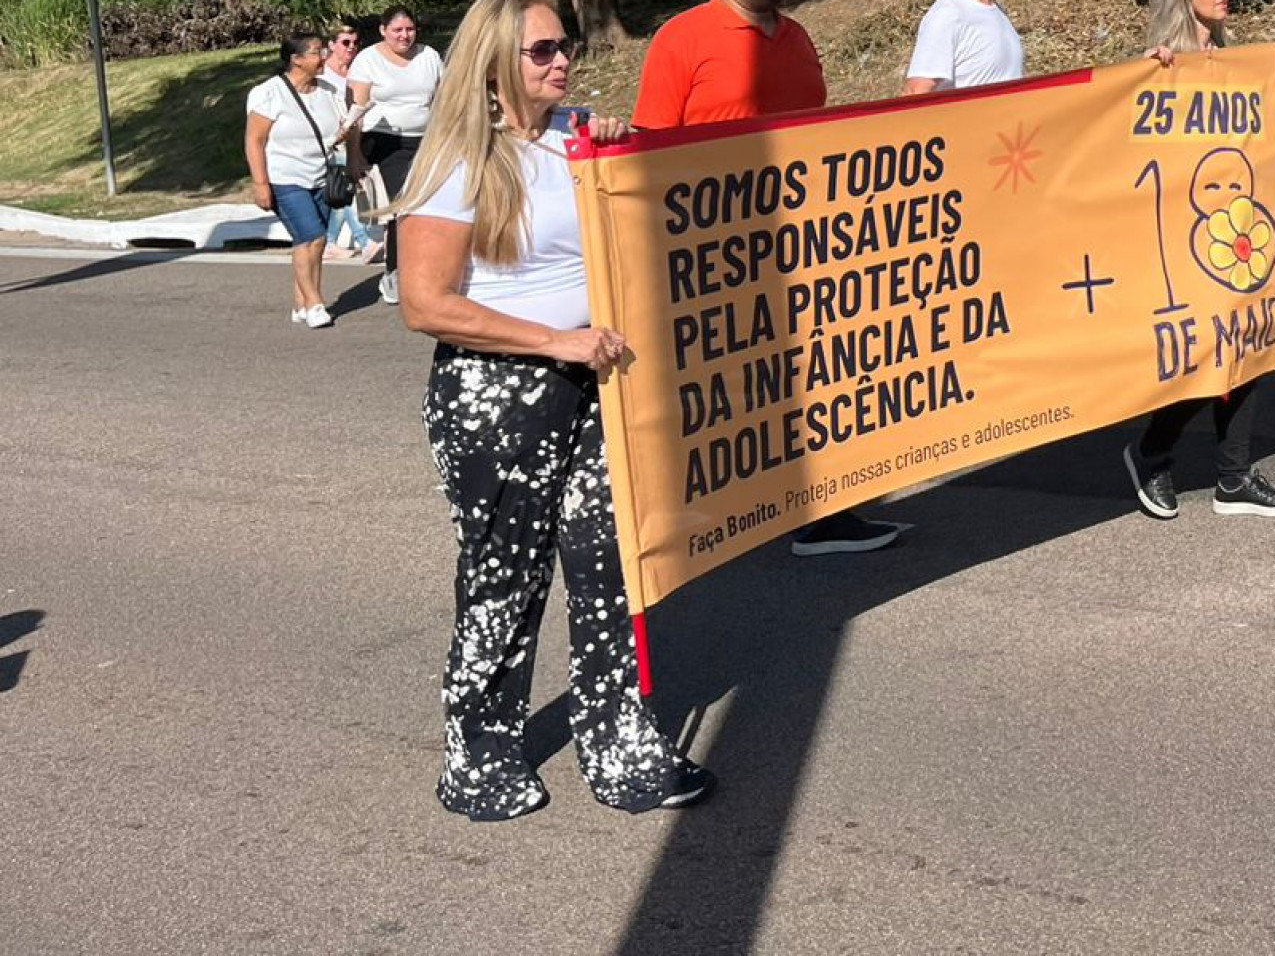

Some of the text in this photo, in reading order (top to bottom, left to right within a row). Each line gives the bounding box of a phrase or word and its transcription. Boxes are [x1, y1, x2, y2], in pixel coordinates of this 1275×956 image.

[1133, 90, 1261, 135] 25 ANOS
[665, 136, 946, 234] SOMOS TODOS
[666, 190, 963, 304] RESPONSÁVEIS
[673, 236, 981, 370] PELA PROTEÇÃO
[679, 291, 1011, 437] DA INFÂNCIA E DA
[1153, 317, 1199, 382] DE
[684, 359, 975, 504] ADOLESCÊNCIA.
[688, 405, 1075, 557] Faça Bonito. Proteja nossas crianças e adolescentes.
